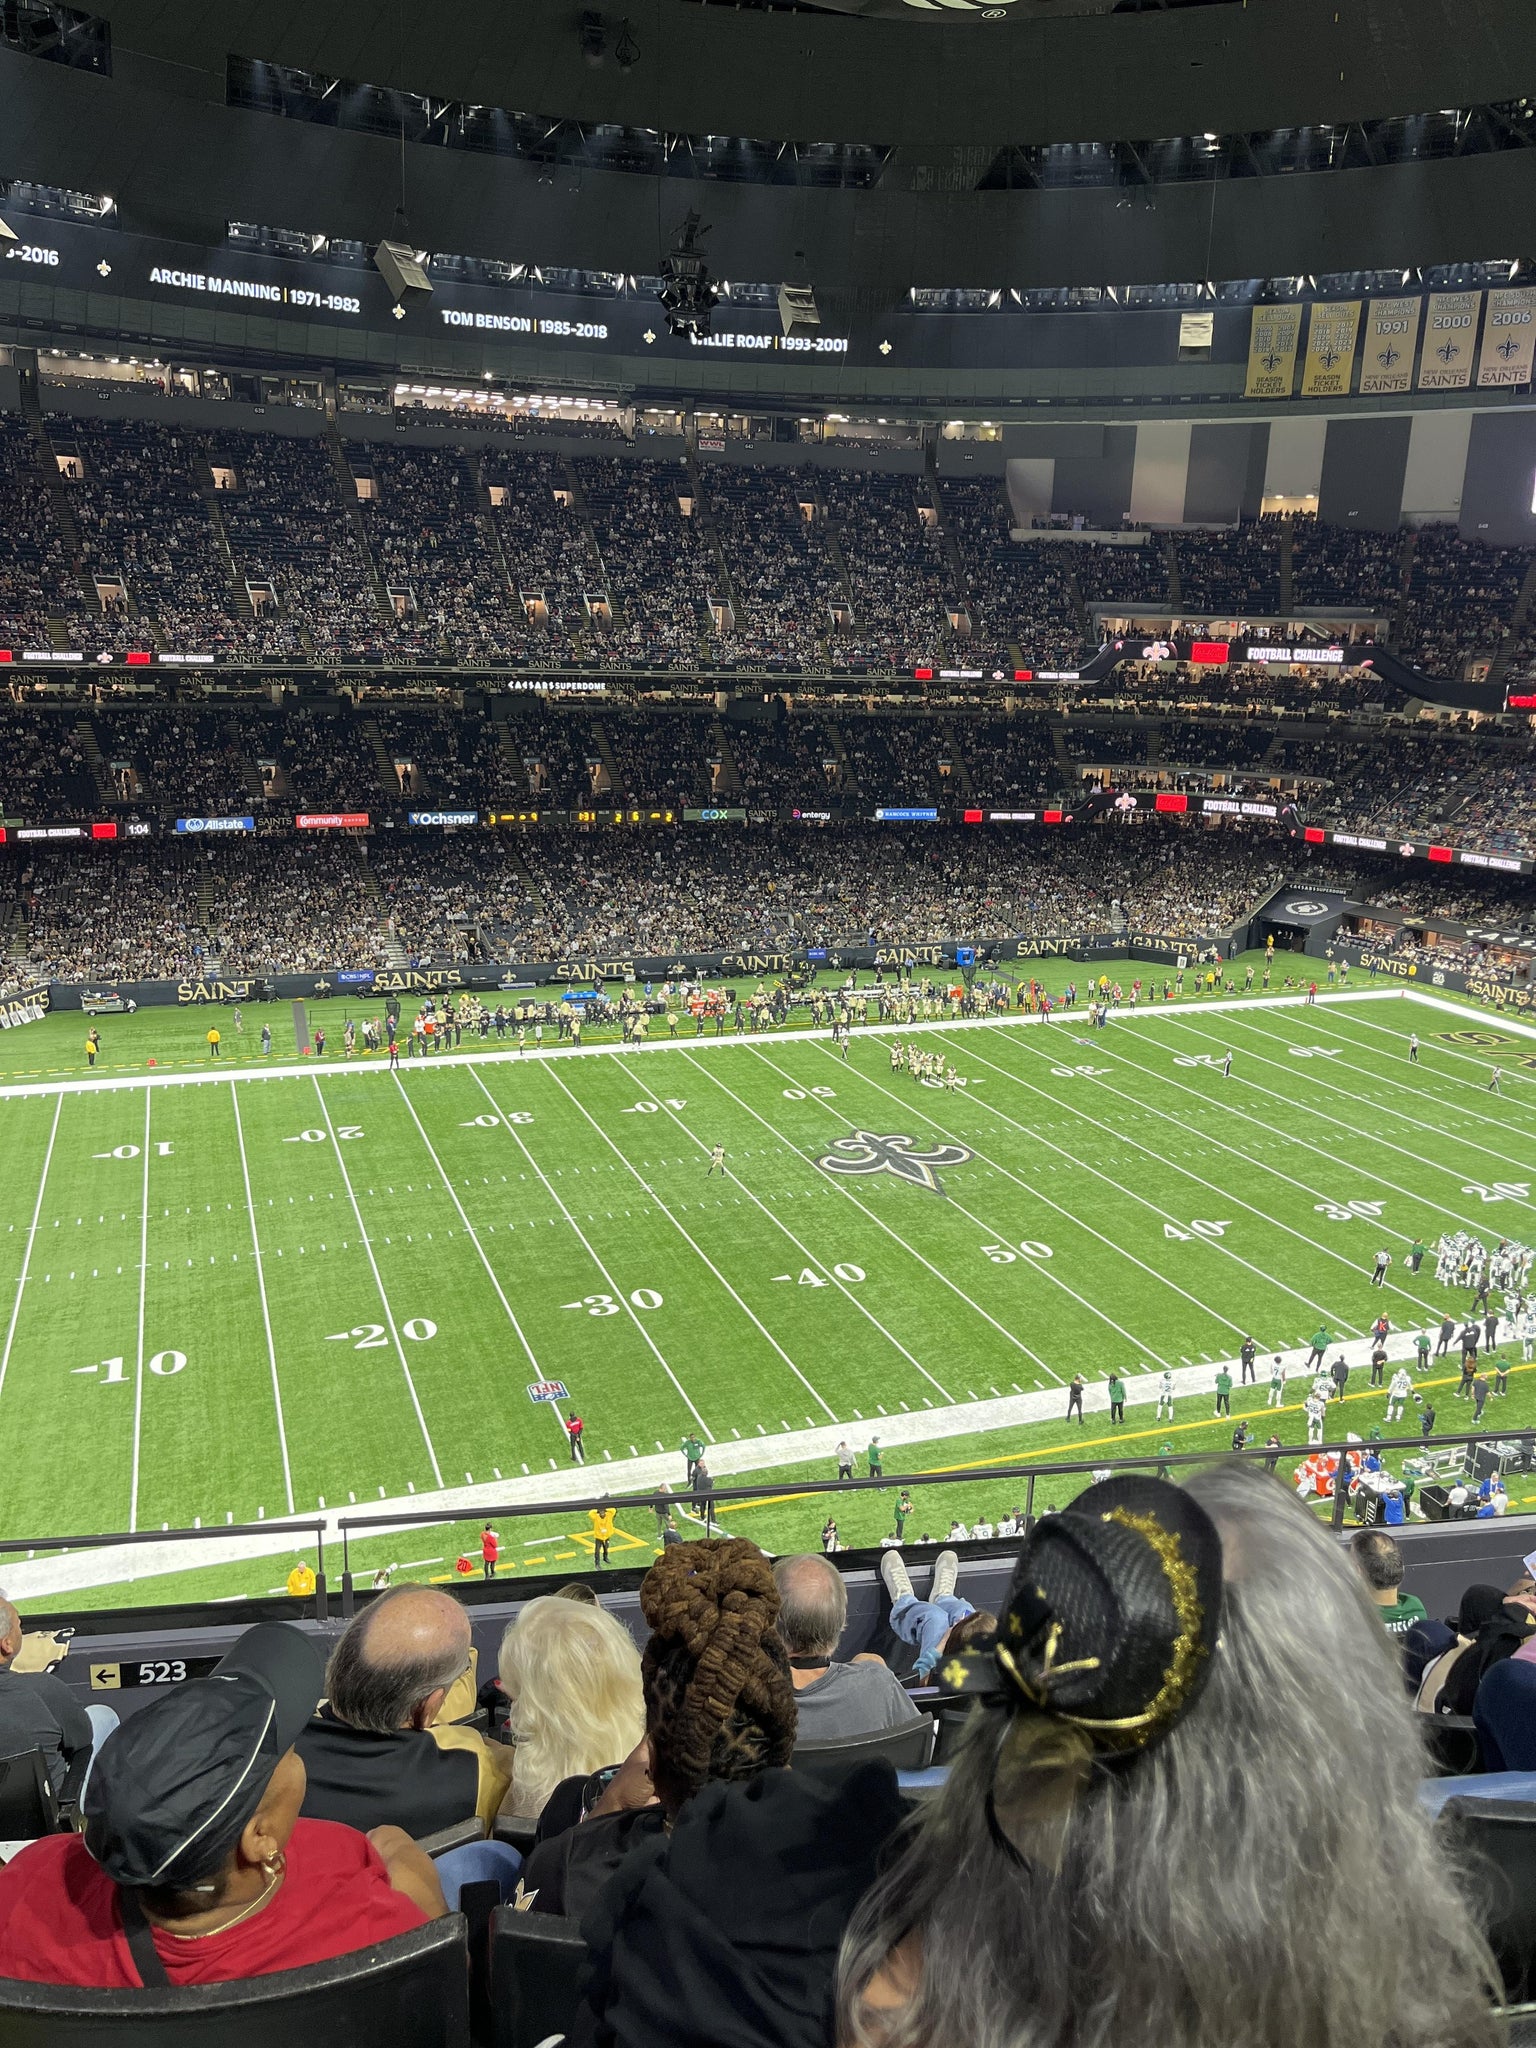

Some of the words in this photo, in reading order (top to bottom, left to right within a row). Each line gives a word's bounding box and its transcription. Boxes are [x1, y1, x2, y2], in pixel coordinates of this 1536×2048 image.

[150, 267, 206, 290] ARCHIE
[208, 276, 281, 301] MANNING
[290, 289, 360, 313] 1971-1982
[441, 310, 474, 327] TOM
[476, 314, 531, 332] BENSON
[540, 320, 607, 339] 1985-2018
[1432, 316, 1472, 329] 2000
[1492, 312, 1532, 326] 2006
[1376, 320, 1408, 334] 1991
[736, 334, 772, 348] ROAF
[781, 337, 848, 353] 1993-2001
[1421, 374, 1467, 386] SAINTS
[1481, 371, 1527, 384] SAINTS
[1363, 379, 1407, 391] SAINTS
[226, 655, 263, 663] SAINTS
[382, 657, 417, 665] SAINTS
[1248, 647, 1291, 661] FOOTBALL
[1293, 648, 1344, 662] CHALLENGE
[457, 659, 491, 667] SAINTS
[600, 662, 632, 670] SAINTS
[668, 663, 699, 671] SAINTS
[736, 665, 767, 673] SAINTS
[10, 675, 48, 683] SAINTS
[867, 668, 897, 676] SAINTS
[98, 676, 135, 684] SAINTS
[180, 677, 215, 685] SAINTS
[508, 681, 554, 690] CAESARS
[555, 682, 605, 690] SUPERDOME
[702, 810, 728, 820] COX
[748, 809, 777, 817] SAINTS
[1203, 800, 1240, 812] FOOTBALL
[1241, 802, 1277, 816] CHALLENGE
[258, 817, 292, 826] SAINTS
[420, 812, 475, 825] Ochsner
[801, 811, 831, 820] entergy
[128, 824, 149, 834] 1:04
[1017, 937, 1081, 956] SAINTS
[556, 961, 634, 980] SAINTS
[375, 969, 461, 988] SAINTS
[178, 980, 256, 1001] SAINT
[1050, 1065, 1103, 1077] 30
[782, 1086, 838, 1100] 50
[635, 1098, 688, 1114] 40
[474, 1111, 535, 1128] 30
[300, 1125, 365, 1143] 20
[112, 1141, 174, 1159] 10
[1461, 1182, 1526, 1203] 20
[1314, 1199, 1383, 1221] 30
[1163, 1219, 1225, 1241] 40
[980, 1240, 1054, 1264] 50
[798, 1262, 867, 1288] 40
[583, 1288, 664, 1316] 30
[350, 1317, 438, 1349] 20
[1379, 1322, 1387, 1331] K
[99, 1350, 187, 1384] 10
[532, 1382, 562, 1394] NFL
[457, 1558, 468, 1572] 20
[139, 1660, 187, 1684] 523
